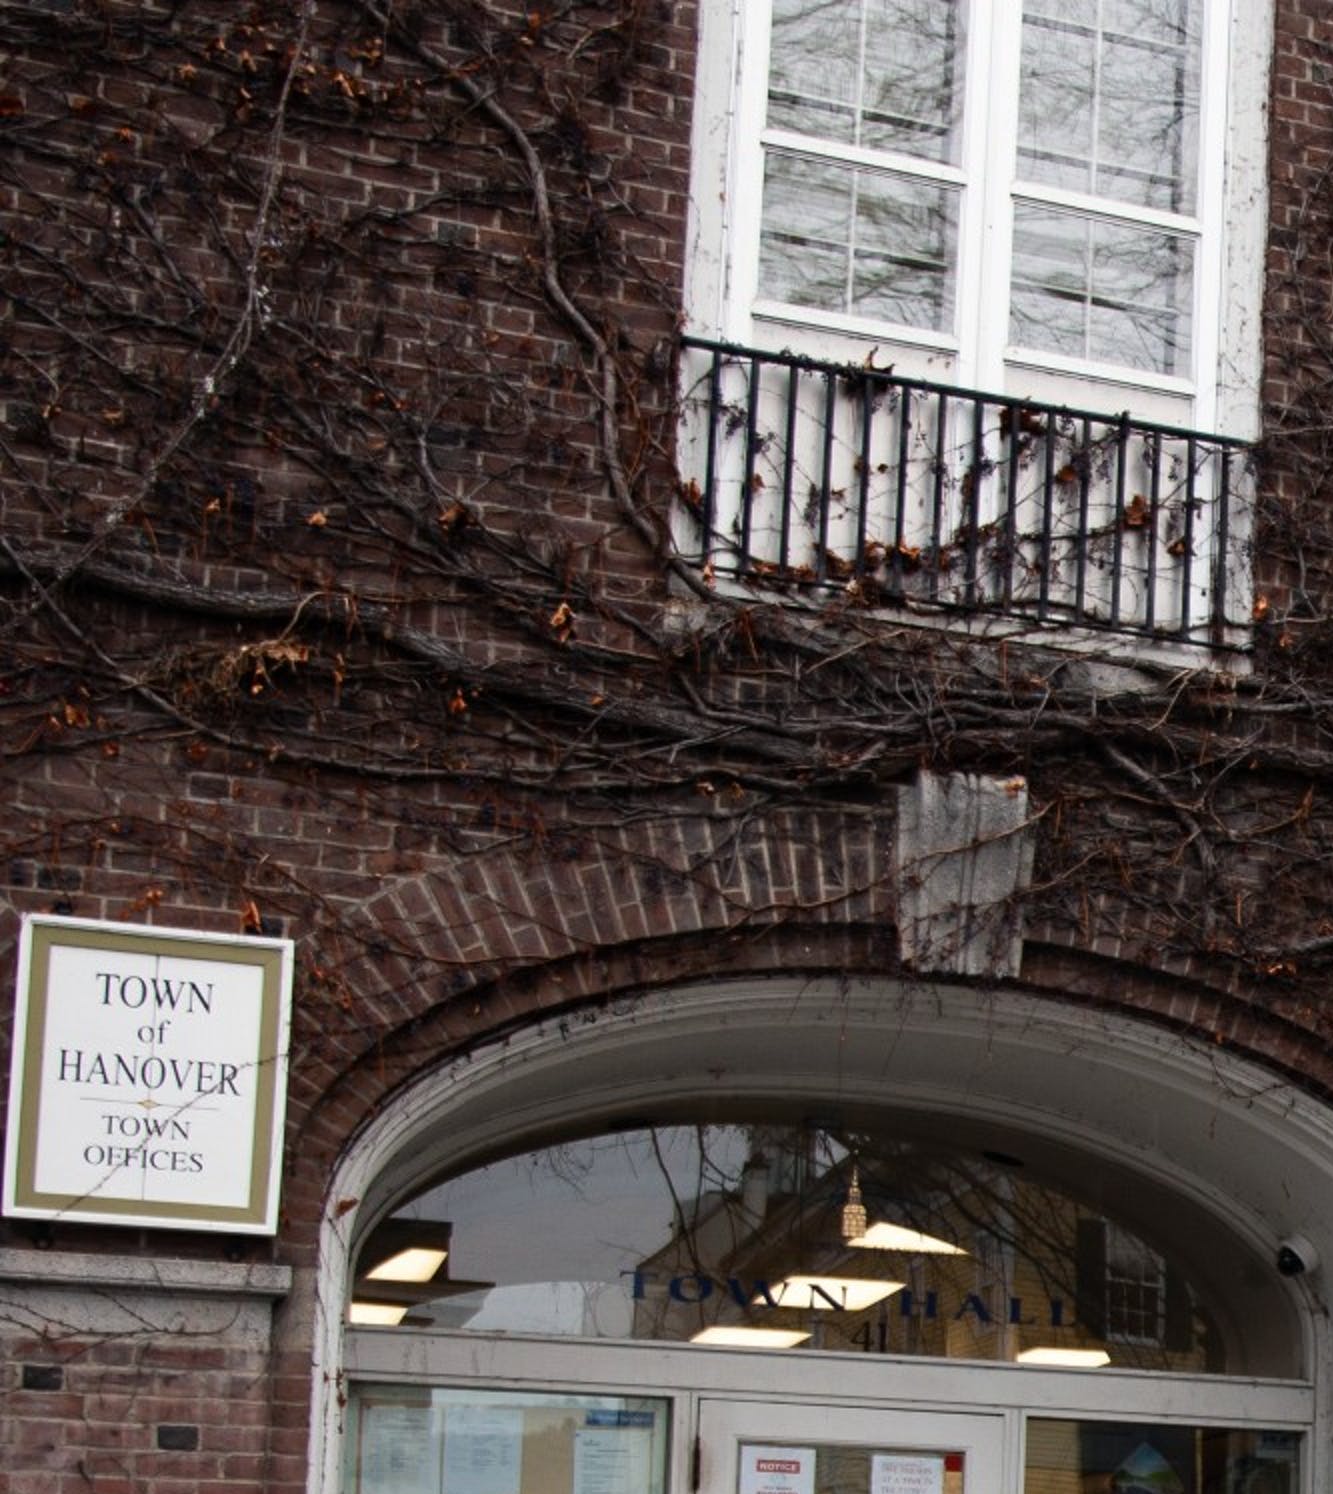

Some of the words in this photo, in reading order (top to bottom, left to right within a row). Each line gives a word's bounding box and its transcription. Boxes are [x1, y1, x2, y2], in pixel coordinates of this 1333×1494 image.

[96, 973, 215, 1015] TOWN
[137, 1021, 172, 1045] of
[57, 1049, 241, 1097] HANOVER
[102, 1115, 192, 1141] TOWN
[83, 1144, 204, 1173] OFFICES
[620, 1271, 848, 1312] TOWN
[900, 1288, 1078, 1327] HALL
[850, 1321, 887, 1352] 41
